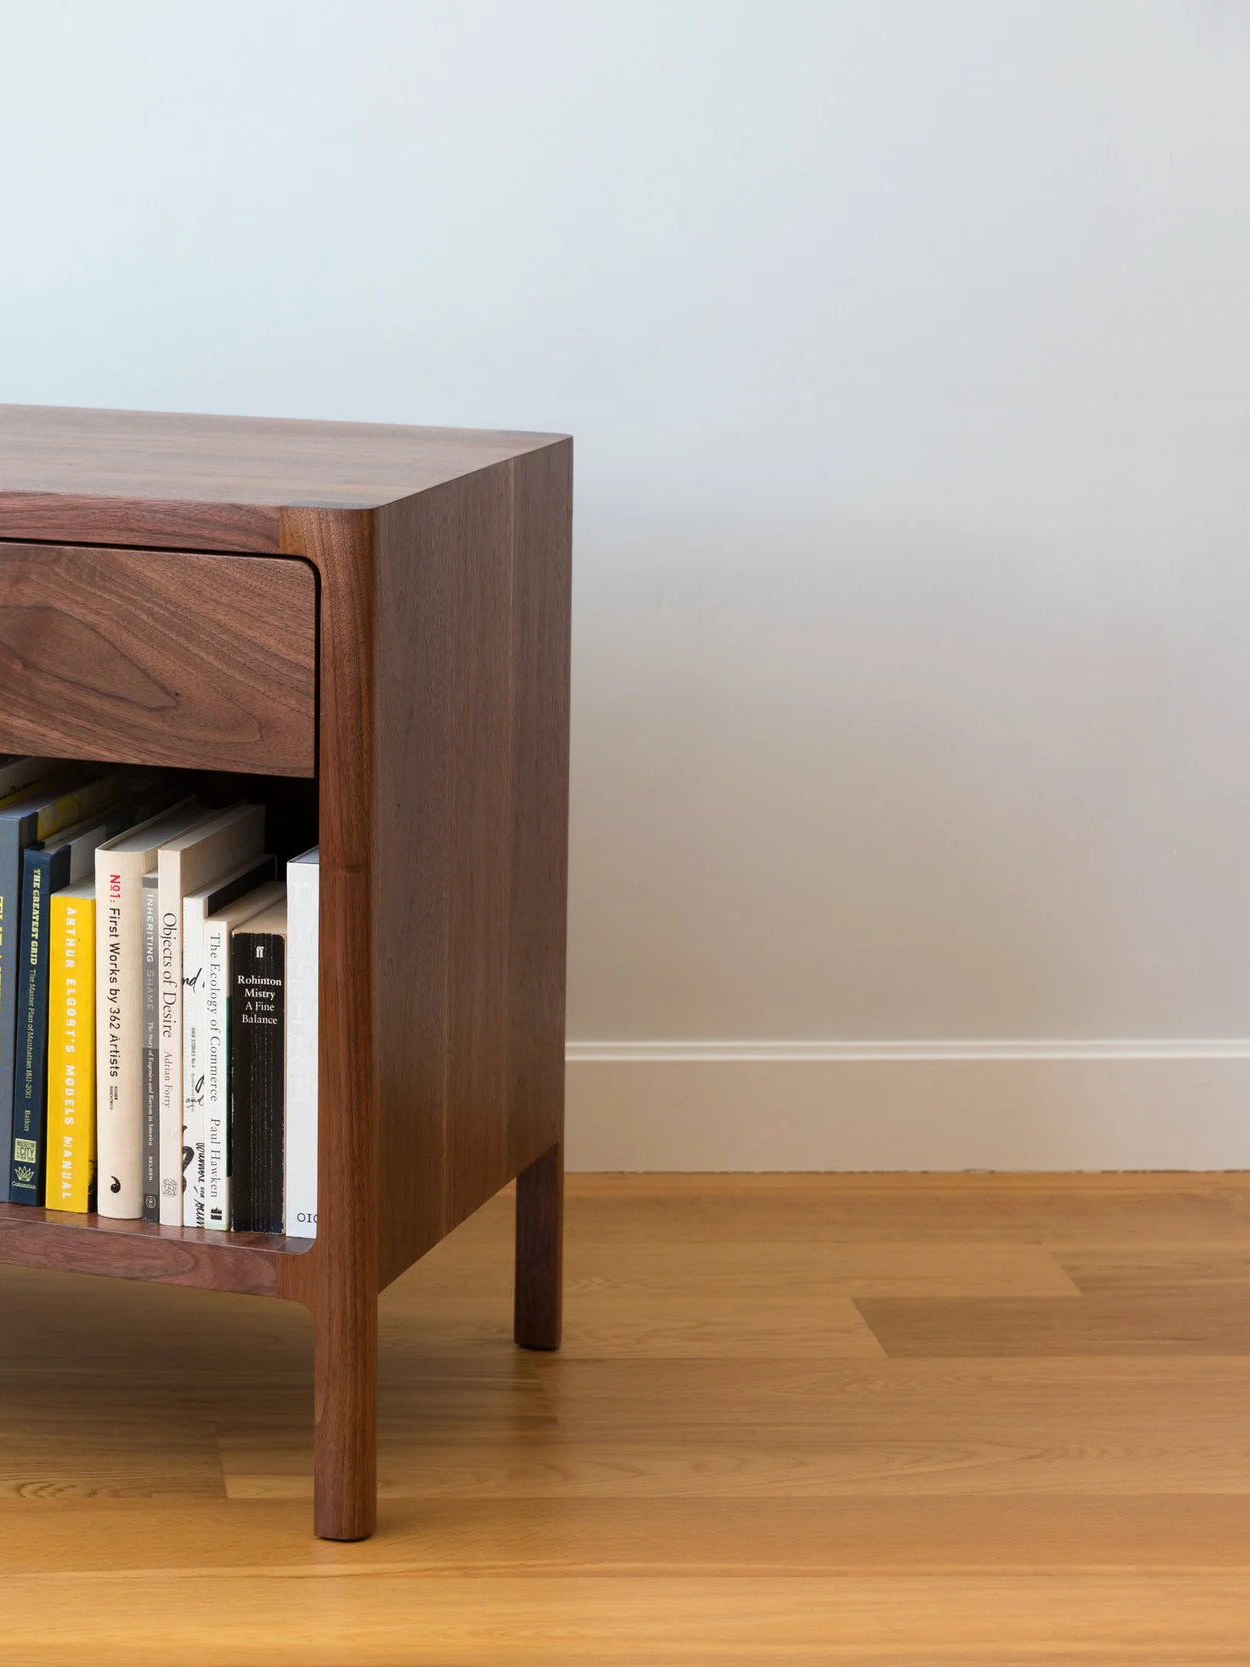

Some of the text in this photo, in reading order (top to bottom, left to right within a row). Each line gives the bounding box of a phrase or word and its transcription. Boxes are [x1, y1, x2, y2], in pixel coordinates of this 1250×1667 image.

[33, 868, 41, 889] THE
[31, 889, 41, 940] GREATEST
[109, 907, 121, 938] First
[146, 893, 155, 964] INHERITING
[30, 939, 39, 966] GRID
[109, 942, 121, 984] Works
[29, 968, 37, 983] The
[237, 974, 283, 986] Rohinton
[27, 982, 36, 1007] Master
[106, 988, 121, 1004] by
[146, 969, 155, 1011] SHAME
[244, 988, 276, 1001] Mistry
[27, 1007, 36, 1024] Plan
[109, 1007, 121, 1030] 362
[159, 912, 178, 1109] Objects of Desire Adrian Forty
[241, 1013, 278, 1025] Balance
[245, 1001, 275, 1012] A Fine
[25, 1031, 35, 1069] Manhattan
[61, 907, 77, 1200] ARTHUR ELGORT'S MODELS MANUAL
[109, 1033, 121, 1078] Artists
[206, 932, 222, 1199] The Ecology of Commerce Paul Hawken
[22, 1109, 32, 1132] Ballon
[19, 1147, 35, 1157] CITY
